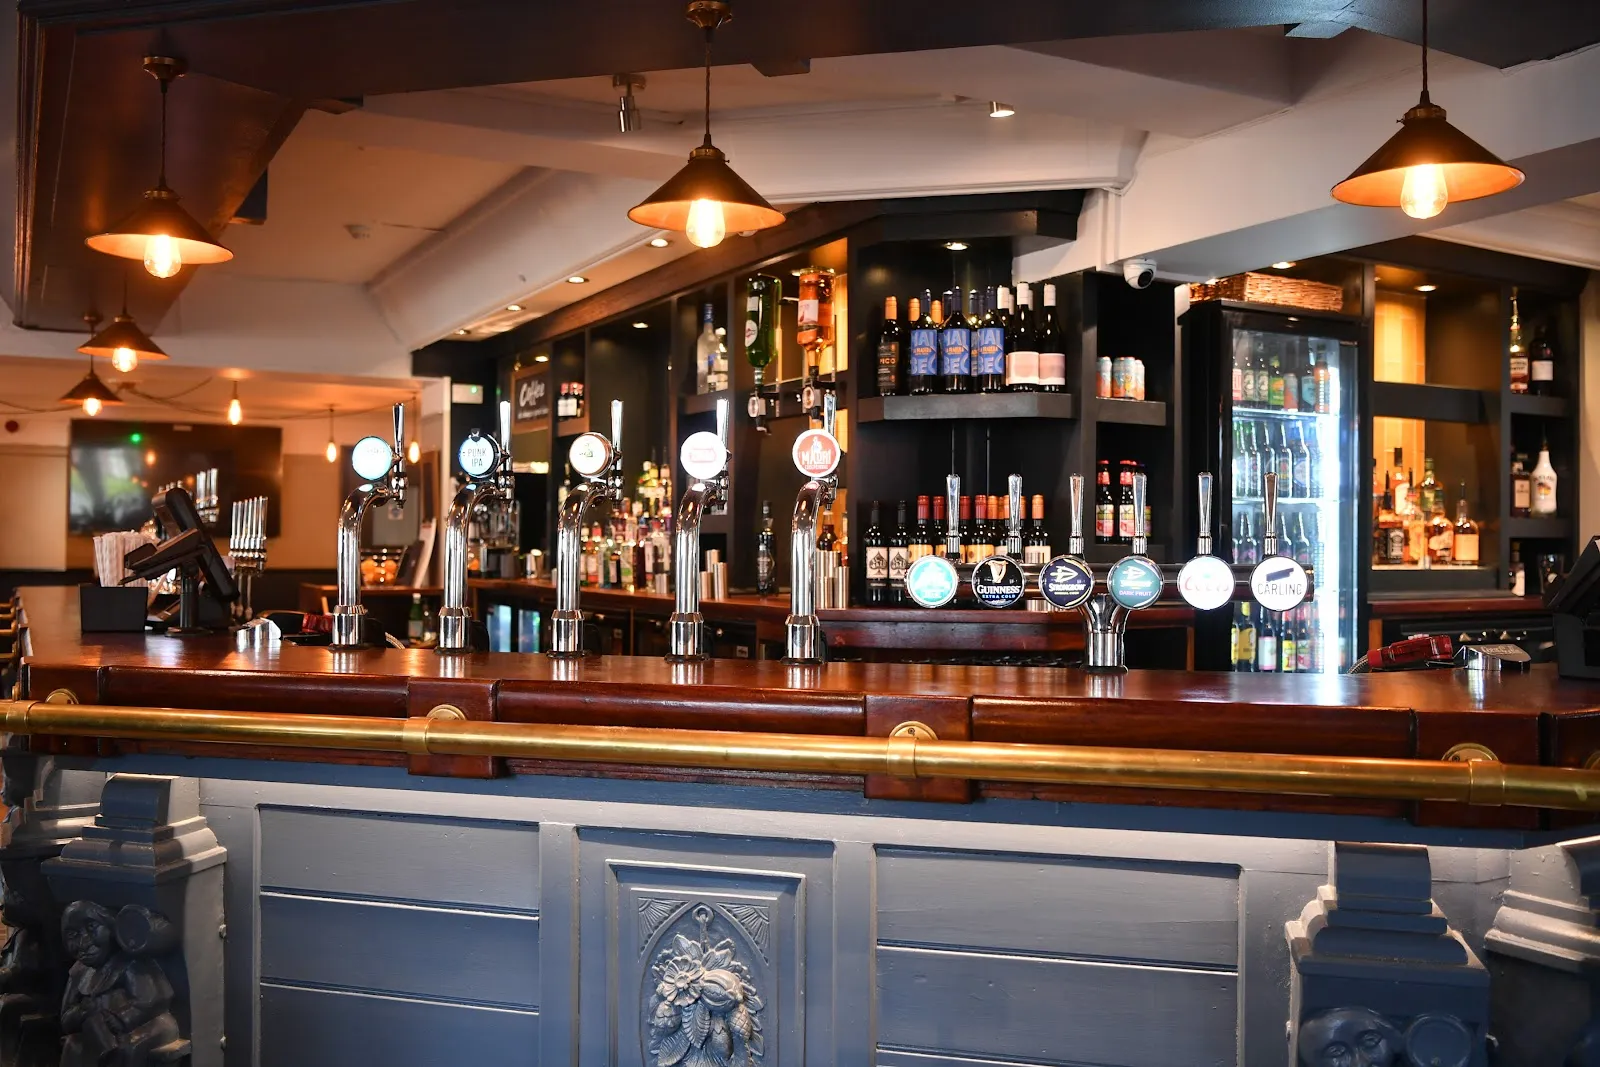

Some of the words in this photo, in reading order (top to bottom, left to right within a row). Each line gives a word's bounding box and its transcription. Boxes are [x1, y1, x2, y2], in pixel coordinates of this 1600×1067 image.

[467, 448, 487, 457] PUNK
[471, 458, 483, 467] IPA
[976, 585, 1021, 594] GUINNESS
[1257, 583, 1302, 595] CARLING
